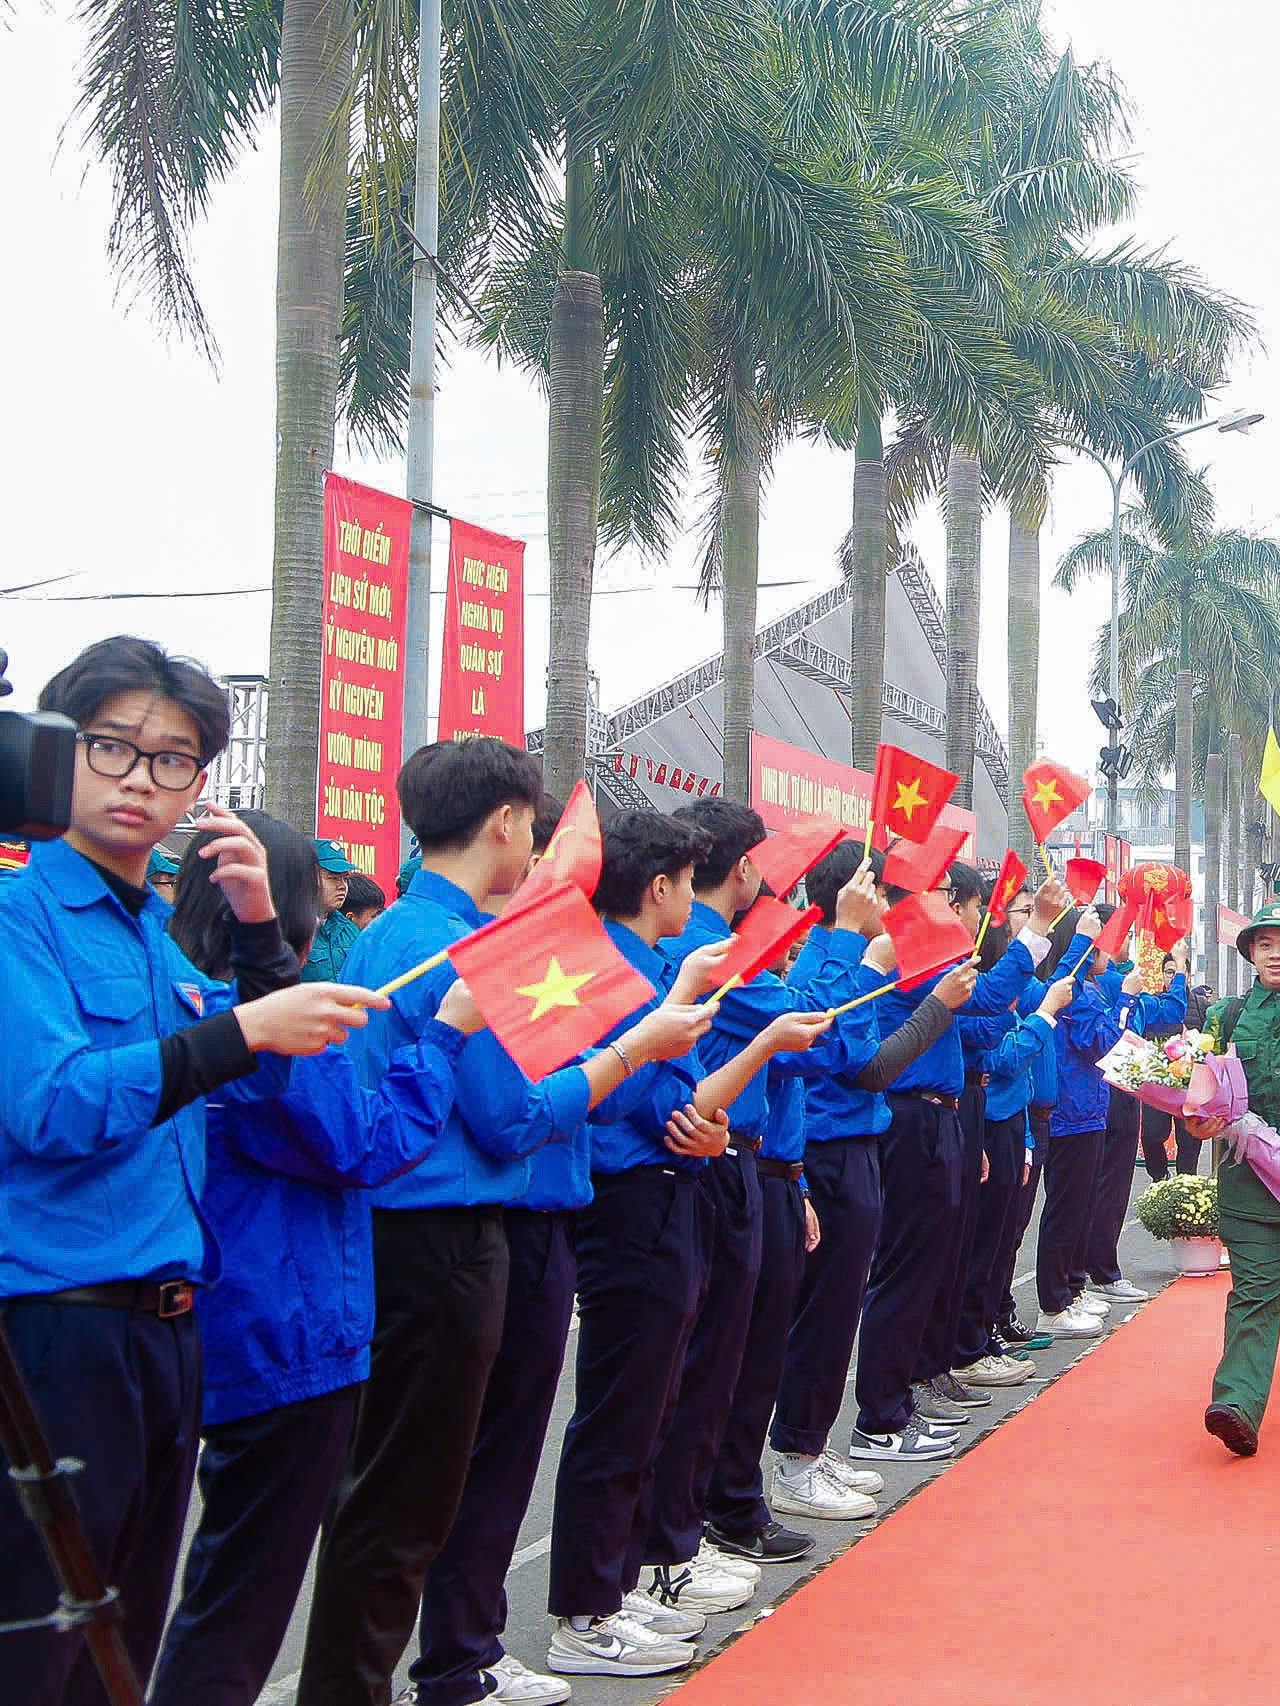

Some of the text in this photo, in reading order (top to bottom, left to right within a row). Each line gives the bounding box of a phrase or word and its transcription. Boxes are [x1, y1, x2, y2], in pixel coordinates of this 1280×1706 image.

[339, 518, 391, 566] THỜI ĐIỂM
[462, 557, 508, 596] THỰC HIỆN
[330, 571, 392, 623] LỊCH SỬ MỚI,
[460, 601, 504, 639] NGHĨA VỤ
[335, 628, 375, 666] NGUYÊN
[377, 636, 398, 672] MỚI
[460, 642, 504, 681] QUÂN SỰ
[328, 671, 385, 721] KỶ NGUYÊN
[471, 686, 485, 716] LÀ
[327, 732, 382, 773] VƯƠN MÌNH
[342, 784, 362, 822] DÂN
[365, 787, 385, 830] TỘC
[351, 843, 376, 875] NAM
[647, 1566, 692, 1605] NY
